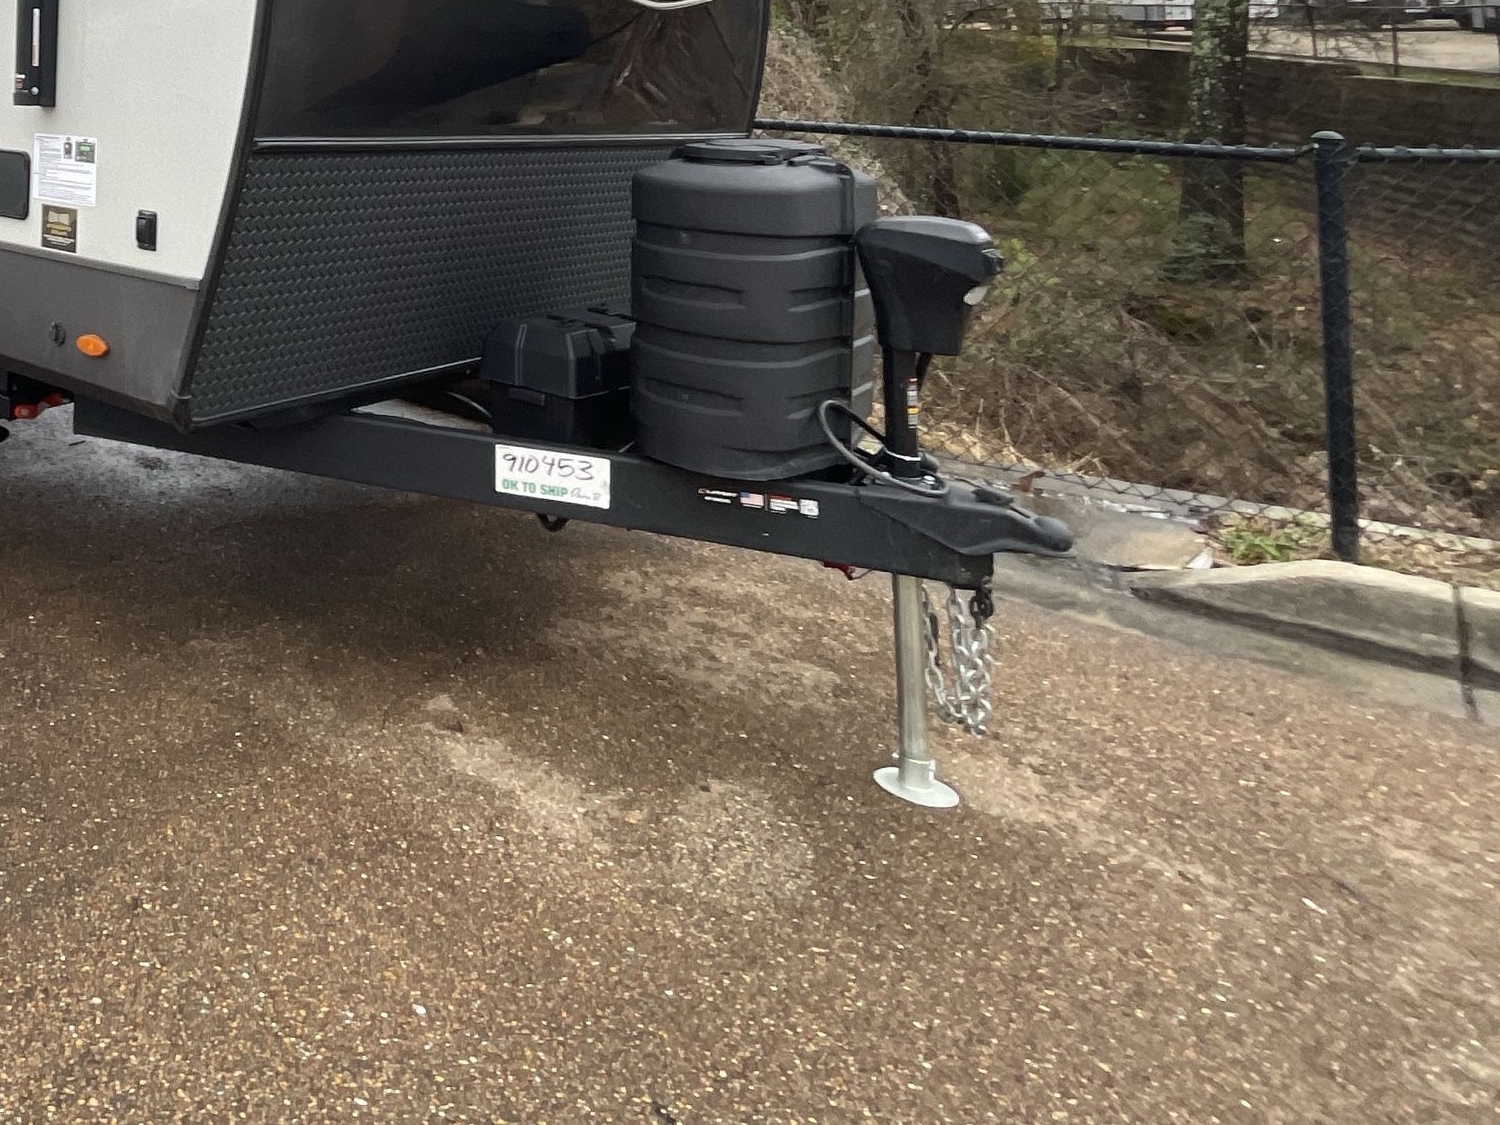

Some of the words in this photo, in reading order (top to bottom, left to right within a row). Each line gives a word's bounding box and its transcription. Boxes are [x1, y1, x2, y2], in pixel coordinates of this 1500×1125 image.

[503, 453, 594, 480] 910453
[502, 478, 519, 491] OK
[522, 481, 536, 493] TO
[540, 484, 568, 497] SHIP
